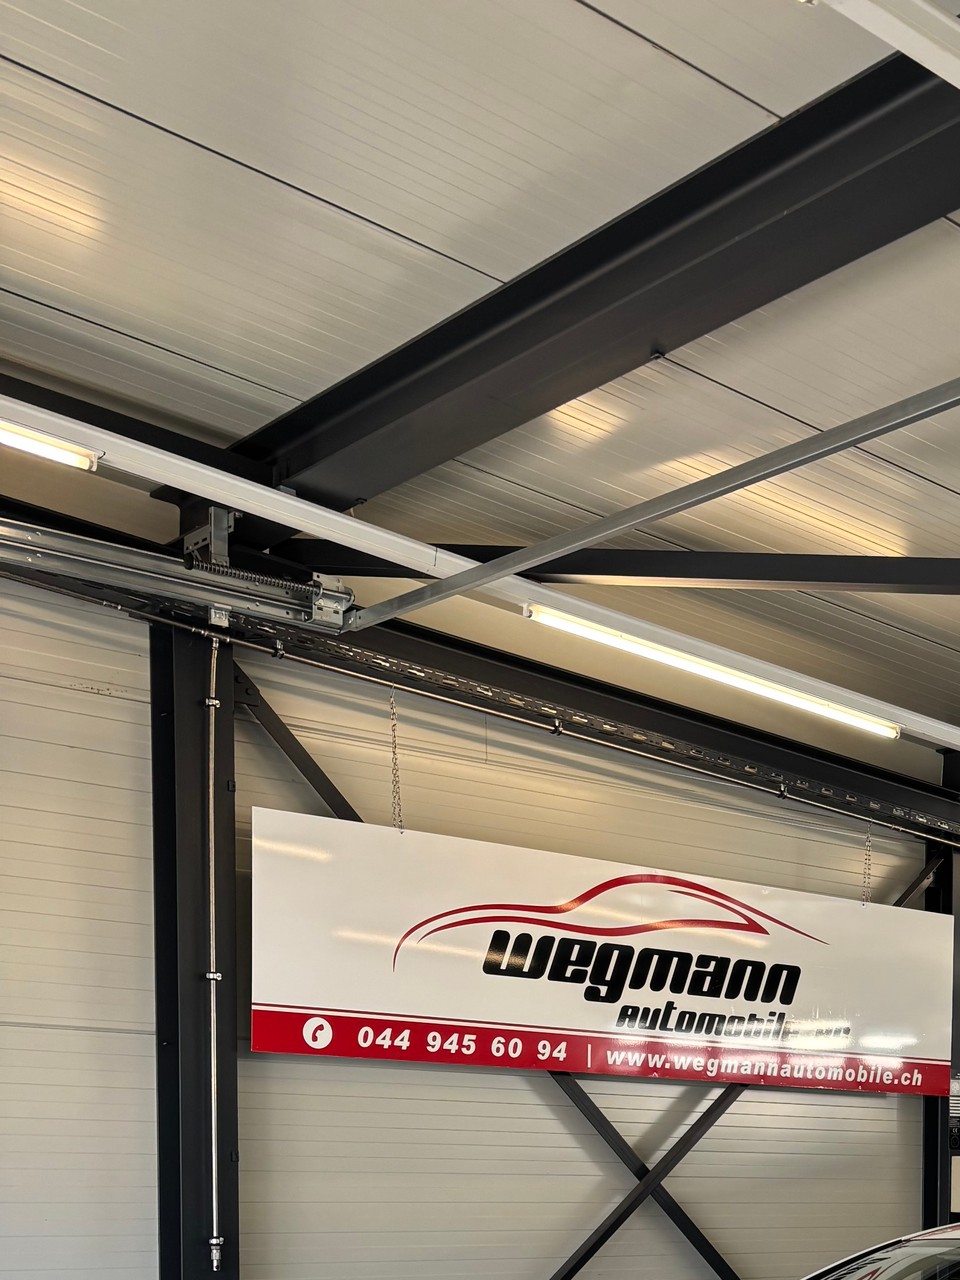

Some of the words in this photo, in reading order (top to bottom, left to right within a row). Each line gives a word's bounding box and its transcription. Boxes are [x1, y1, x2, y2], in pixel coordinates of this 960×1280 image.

[482, 929, 801, 1005] wegmann
[357, 1026, 411, 1050] 044
[426, 1031, 477, 1055] 945
[491, 1037, 523, 1058] 60
[537, 1040, 567, 1061] 94
[606, 1050, 923, 1086] www.wegmannautomobile.ch
